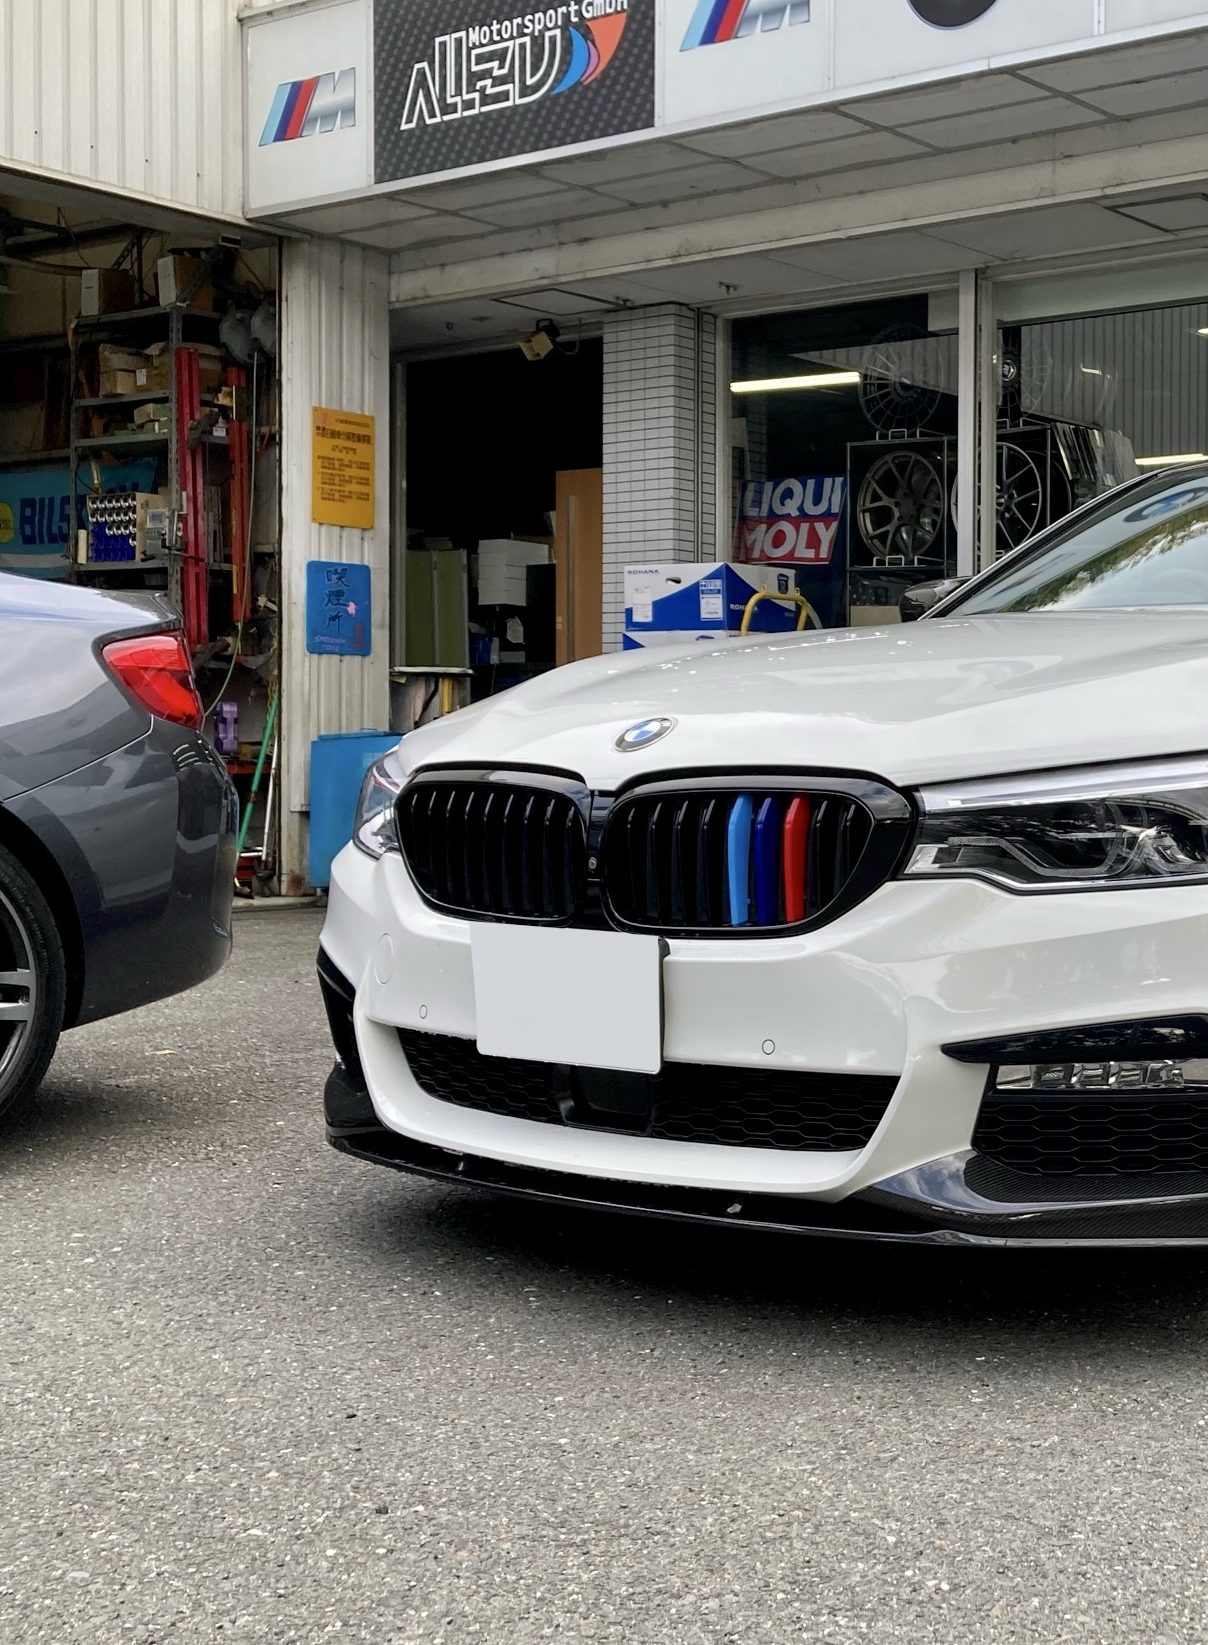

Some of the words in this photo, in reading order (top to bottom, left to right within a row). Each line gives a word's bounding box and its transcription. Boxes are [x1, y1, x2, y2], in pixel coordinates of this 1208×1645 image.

[468, 1, 580, 48] Motorsport
[743, 477, 845, 517] LIQUI
[740, 521, 838, 558] MOLY
[729, 603, 759, 612] ROHA
